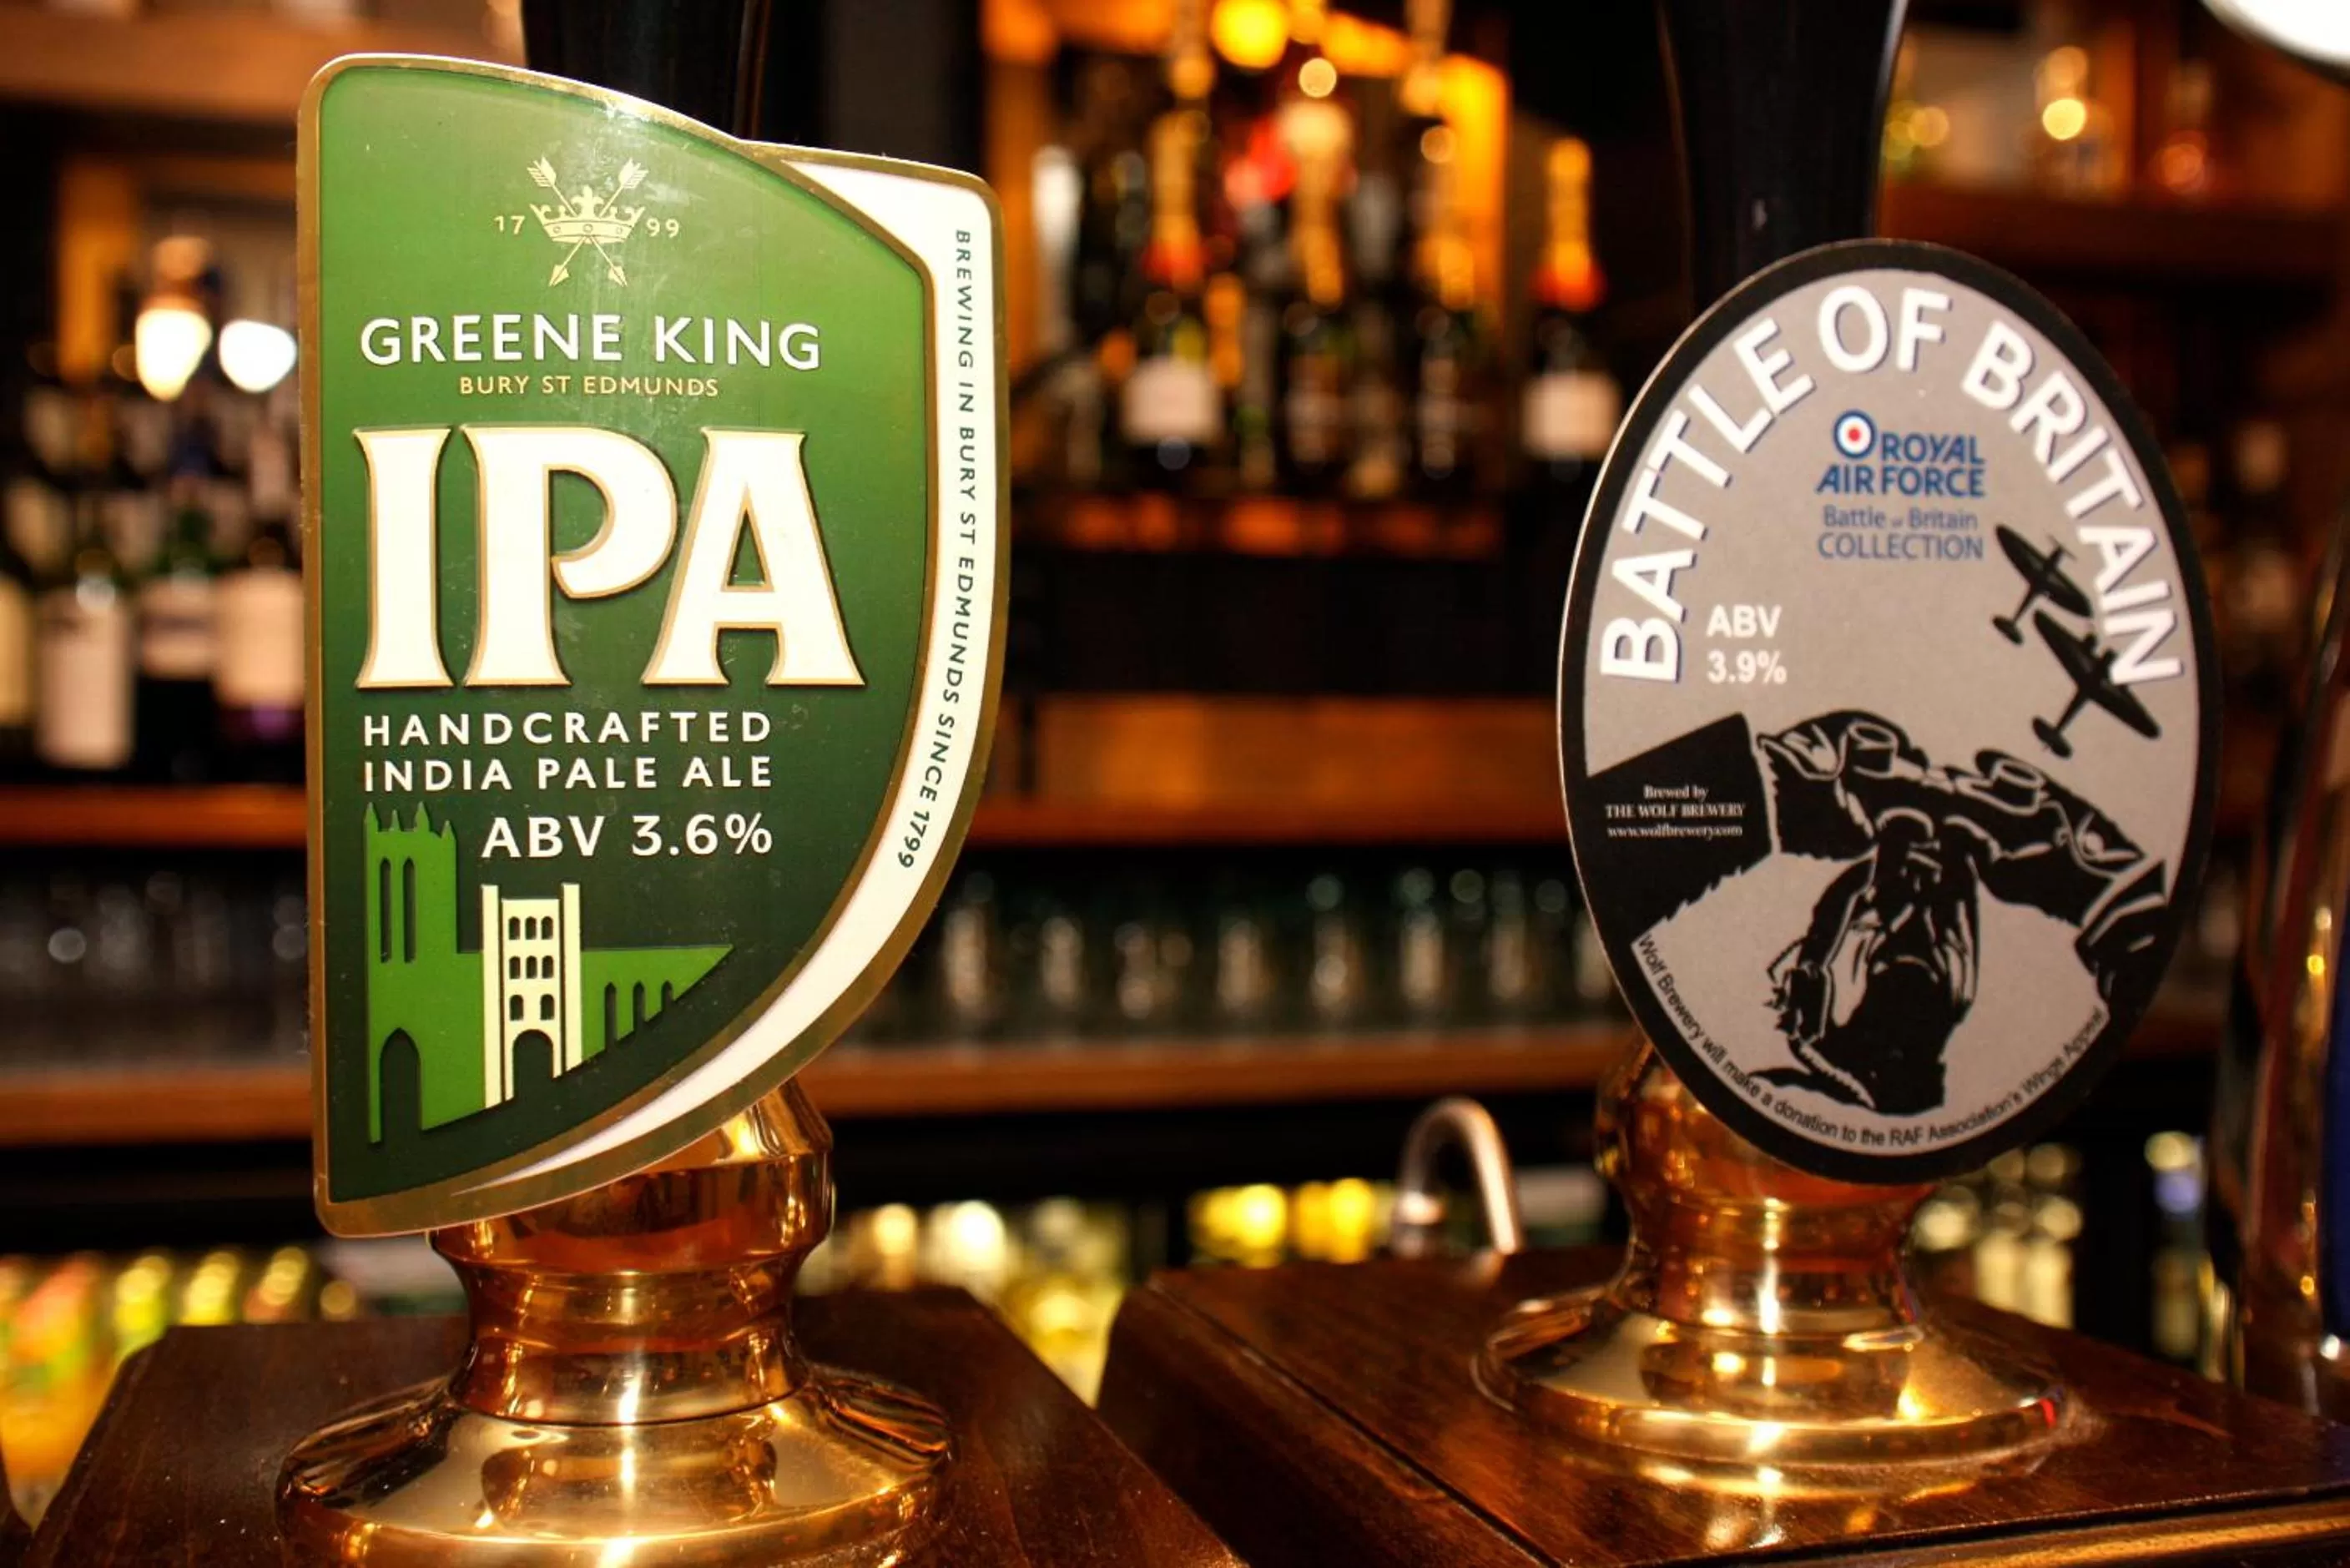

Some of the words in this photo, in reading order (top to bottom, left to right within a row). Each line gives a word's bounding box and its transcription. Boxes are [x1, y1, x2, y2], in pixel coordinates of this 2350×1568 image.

[494, 215, 526, 235] 17
[646, 218, 681, 238] 99
[956, 229, 975, 368] BREWING
[361, 314, 623, 366] GREENE
[654, 316, 823, 371] KING
[460, 376, 528, 396] BURY
[541, 376, 572, 396] ST
[583, 377, 719, 397] EDMUNDS
[959, 381, 975, 412] IN
[959, 426, 976, 501] BURY
[1881, 431, 1985, 465] ROYAL
[1599, 316, 1816, 683] BATTLE
[1817, 285, 1952, 374] OF
[1961, 320, 2183, 685] BRITAIN
[1814, 463, 1875, 495] AIR
[1881, 465, 1986, 497] FORCE
[960, 512, 976, 544] ST
[1823, 504, 1886, 528] Battle
[1909, 506, 1978, 530] Britain
[352, 424, 865, 688] IPA
[1818, 532, 1984, 561] COLLECTION
[943, 557, 975, 704] EDMUNDS
[1707, 605, 1782, 638] ABV
[1707, 650, 1788, 684] 3.9%
[363, 712, 773, 747] HANDCRAFTED
[363, 759, 513, 792] INDIA
[537, 757, 658, 790] PALE
[682, 755, 773, 789] ALE
[920, 713, 955, 802] SINCE
[1605, 804, 1635, 819] THE
[1637, 804, 1678, 819] WOLF
[1680, 802, 1746, 818] BREWERY
[1643, 784, 1689, 799] Brewed
[1692, 784, 1709, 803] by
[481, 814, 605, 859] ABV
[631, 813, 774, 857] 3.6%
[898, 809, 930, 869] 1799
[1638, 934, 1667, 976] Wolf
[1657, 972, 1704, 1041] Brewery
[1702, 1038, 1729, 1066] will
[1723, 1060, 1762, 1100] make
[1760, 1093, 1773, 1107] a
[1774, 1100, 1838, 1137] donation
[1842, 1126, 1857, 1142] to
[1860, 1127, 1885, 1147] the
[1889, 1127, 1924, 1147] RAF
